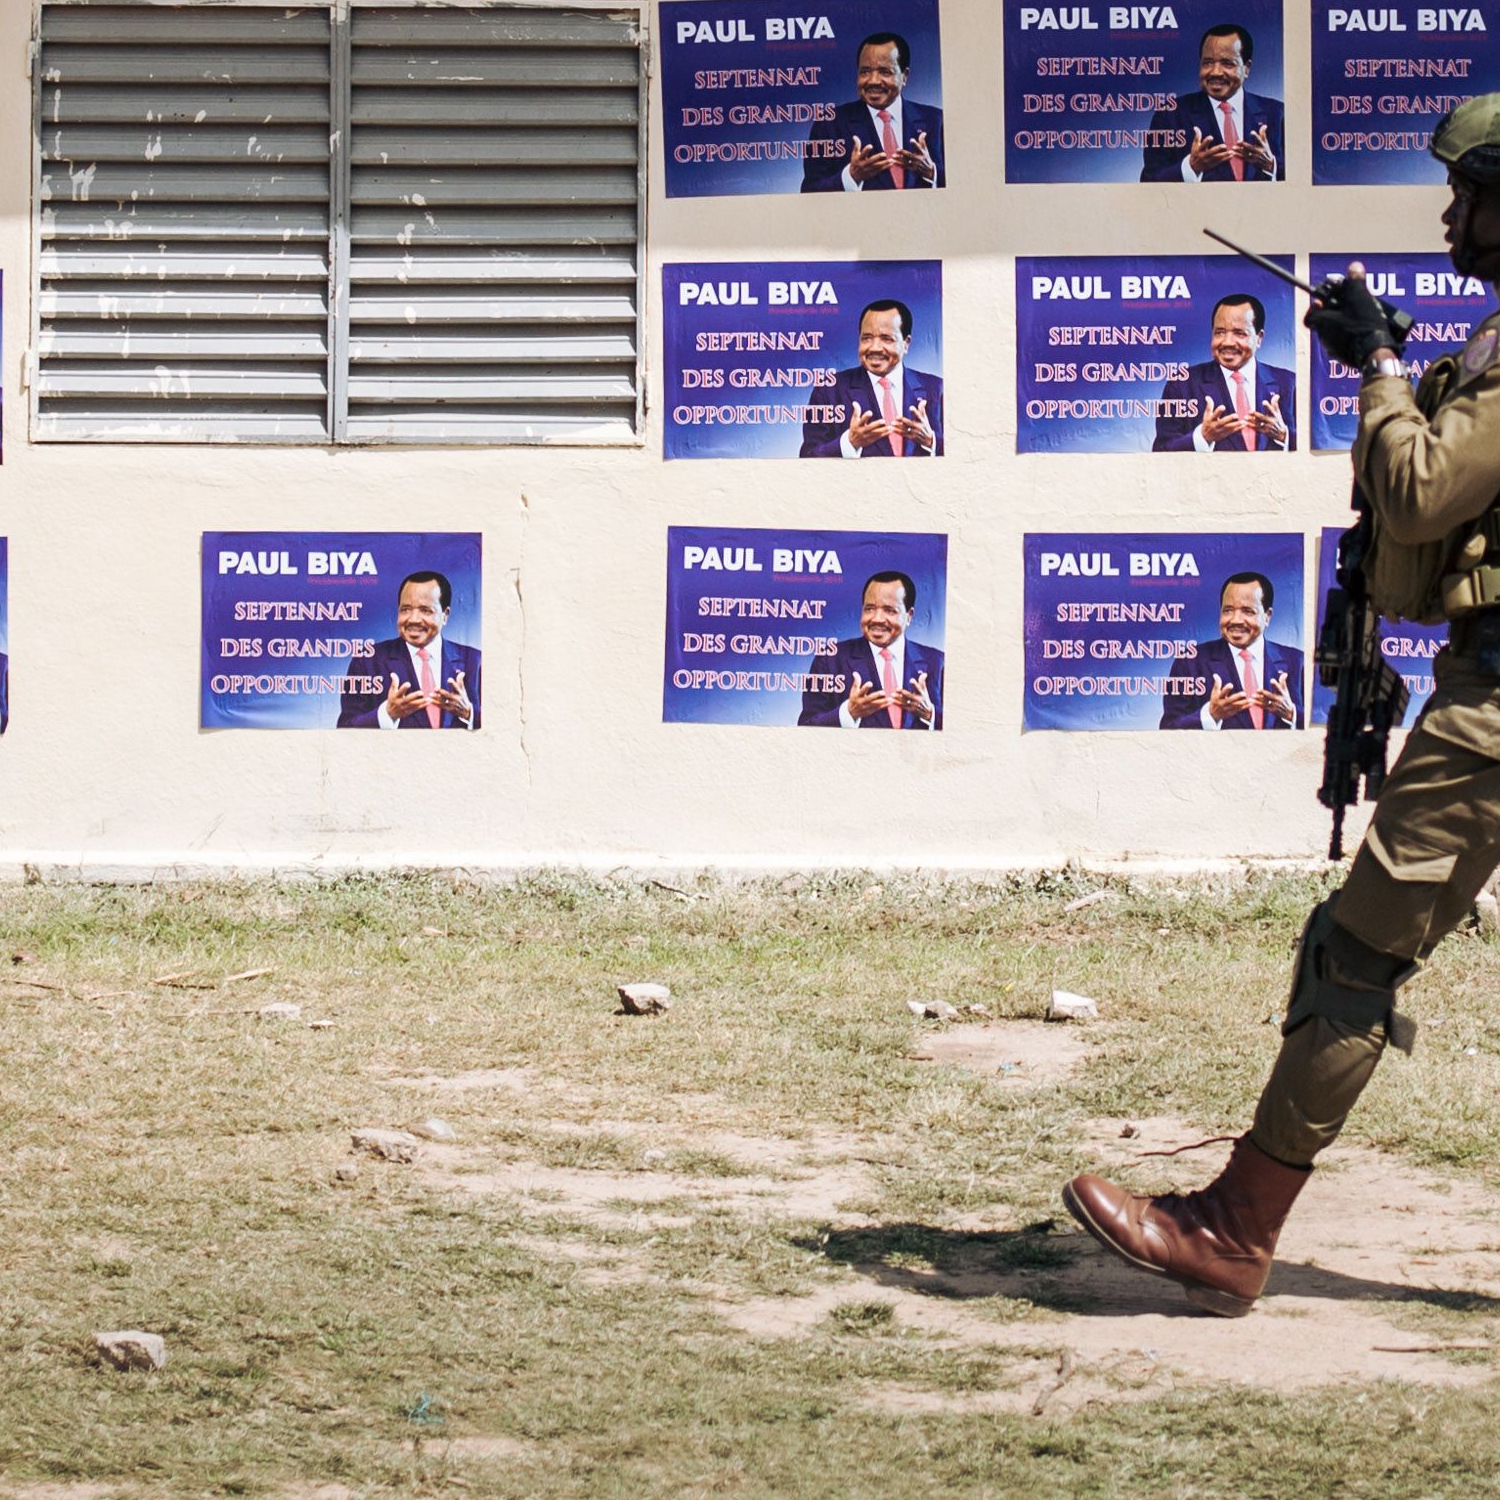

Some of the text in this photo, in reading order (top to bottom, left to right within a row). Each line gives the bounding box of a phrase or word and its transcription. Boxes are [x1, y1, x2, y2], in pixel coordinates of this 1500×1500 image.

[1020, 6, 1178, 30] PAUL BIYA
[1328, 8, 1486, 31] PAUL BIYA
[676, 15, 834, 44] PAUL BIYA
[1037, 56, 1163, 76] SEPTENNAT
[1344, 58, 1471, 77] SEPTENNAT
[694, 66, 821, 89] SEPTENNAT
[1022, 92, 1177, 112] DES GRANDES
[1330, 95, 1372, 114] DES
[681, 102, 836, 126] DES GRANDES
[1013, 129, 1186, 149] OPPORTUNITES
[1321, 131, 1432, 150] OPPORTU
[673, 138, 846, 163] OPPORTUNITES
[679, 281, 837, 305] PAUL BIYA
[1032, 275, 1190, 299] PAUL BIYA
[1415, 273, 1484, 296] BIYA
[696, 331, 823, 351] SEPTENNAT
[1049, 325, 1175, 345] SEPTENNAT
[681, 368, 836, 387] DES GRANDES
[1034, 362, 1189, 382] DES GRANDES
[672, 404, 845, 424] OPPORTUNITES
[1025, 399, 1198, 418] OPPORTUNITES
[218, 551, 377, 575] PAUL BIYA
[683, 545, 842, 574] PAUL BIYA
[1040, 552, 1198, 576] PAUL BIYA
[235, 601, 362, 621] SEPTENNAT
[699, 596, 825, 619] SEPTENNAT
[1057, 602, 1184, 622] SEPTENNAT
[219, 638, 375, 658] DES GRANDES
[683, 632, 838, 656] DES GRANDES
[1042, 639, 1197, 659] DES GRANDES
[210, 674, 383, 694] OPPORTUNITES
[672, 669, 845, 693] OPPORTUNITES
[1033, 676, 1206, 695] OPPORTUNITES
